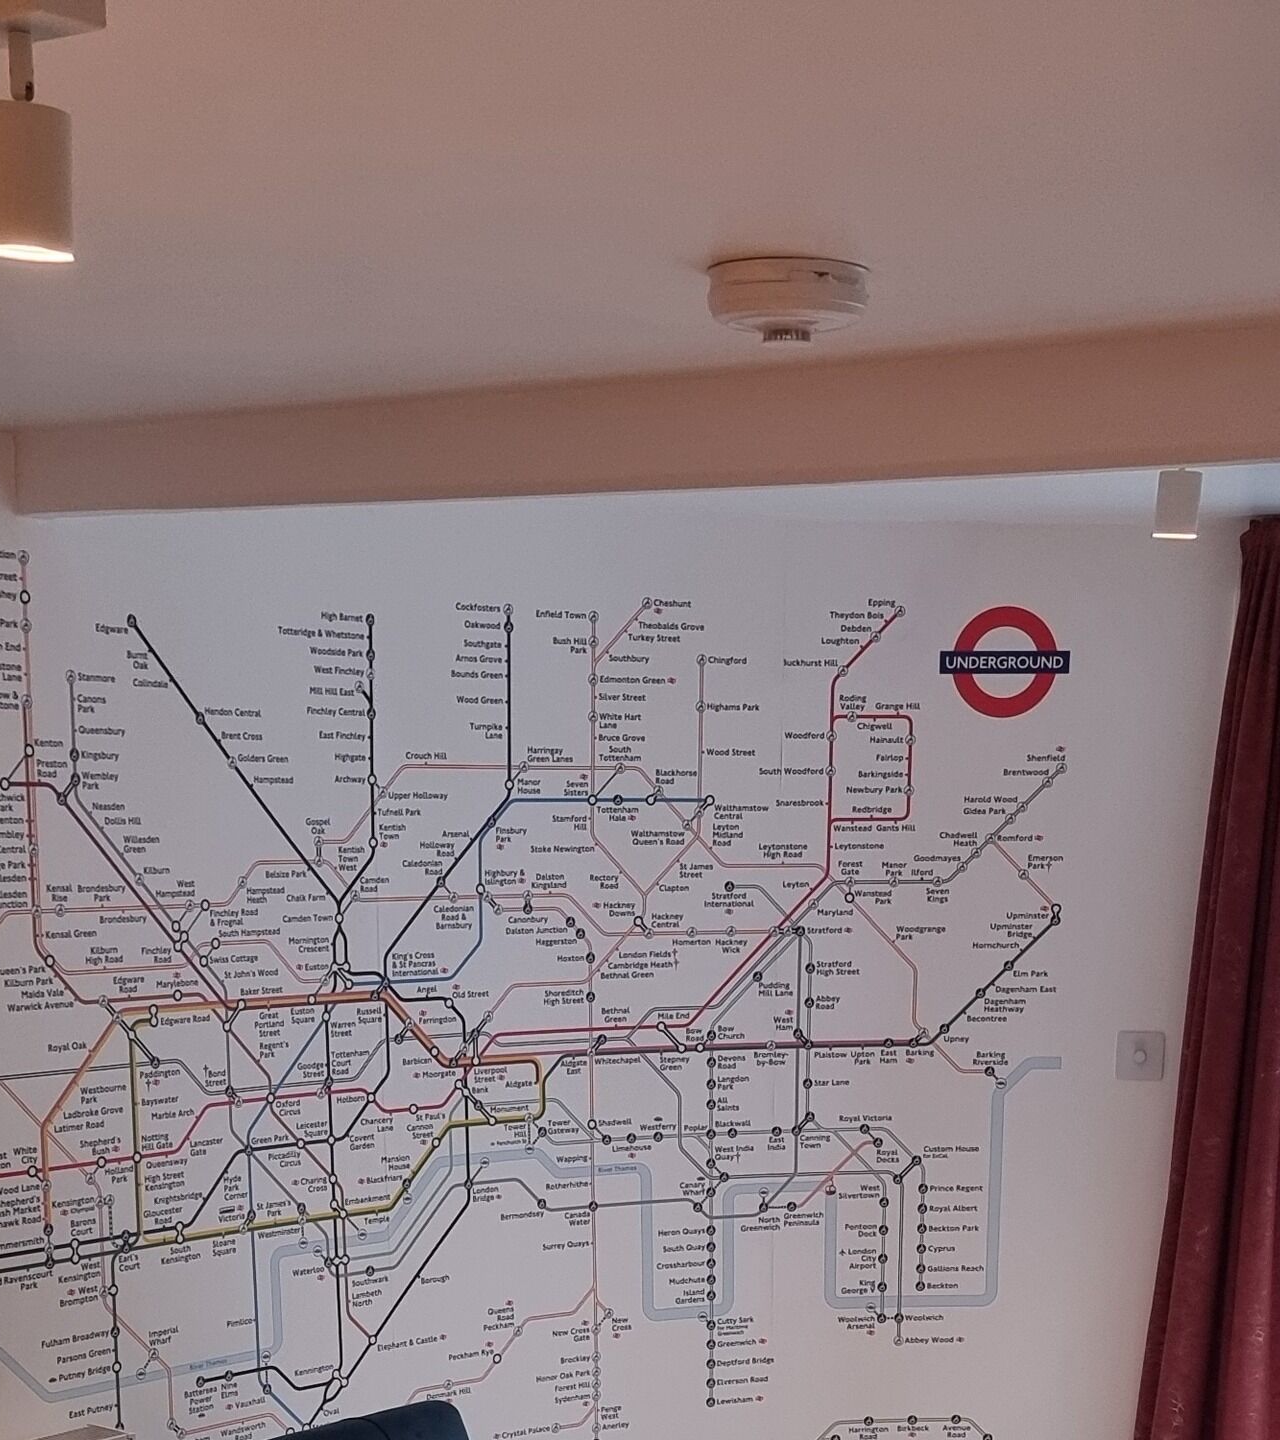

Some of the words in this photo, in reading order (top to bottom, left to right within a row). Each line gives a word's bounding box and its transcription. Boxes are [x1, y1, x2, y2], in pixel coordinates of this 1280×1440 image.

[456, 603, 500, 612] Cockfosters
[868, 599, 895, 608] Epping
[321, 612, 337, 622] High
[340, 613, 362, 622] Barnet
[536, 610, 568, 618] Enfield
[567, 611, 586, 619] Town
[0, 619, 18, 628] Park
[465, 621, 500, 630] Oakwood
[96, 623, 130, 634] Edgware
[821, 638, 859, 646] Loughton
[310, 647, 345, 656] Woodside
[347, 649, 363, 657] Park
[609, 655, 649, 663] Southbury
[708, 656, 747, 665] Chingford
[945, 656, 1064, 669] UNDERGROUND
[314, 666, 332, 674] West
[335, 667, 364, 676] Finchley
[78, 673, 115, 682] Stanmore
[600, 676, 640, 684] Edmonton
[133, 678, 168, 688] Colindale
[707, 703, 740, 712] Highams
[875, 703, 903, 711] Grange
[307, 707, 336, 716] Finchley
[339, 708, 365, 717] Central
[78, 726, 125, 736] Queensbury
[220, 732, 241, 740] Brent
[243, 732, 262, 740] Cross
[32, 739, 63, 747] Kenton
[81, 751, 119, 761] Kingsbury
[238, 754, 265, 762] Golders
[267, 755, 288, 763] Green
[335, 754, 366, 762] Highgate
[254, 776, 293, 785] Hampstead
[335, 776, 365, 784] Archway
[846, 787, 883, 795] Newbury
[852, 806, 892, 815] Redbridge
[996, 833, 1033, 841] Romford
[1007, 911, 1049, 920] Upminster
[156, 978, 198, 991] Marylebone
[906, 1050, 934, 1059] Barking
[594, 1056, 641, 1065] Whitechapel
[142, 1096, 178, 1106] Bayswater
[956, 1185, 982, 1193] Regent
[154, 1191, 202, 1206] Knightsbridge
[292, 1267, 325, 1277] Waterloo
[295, 1365, 334, 1378] Kennington
